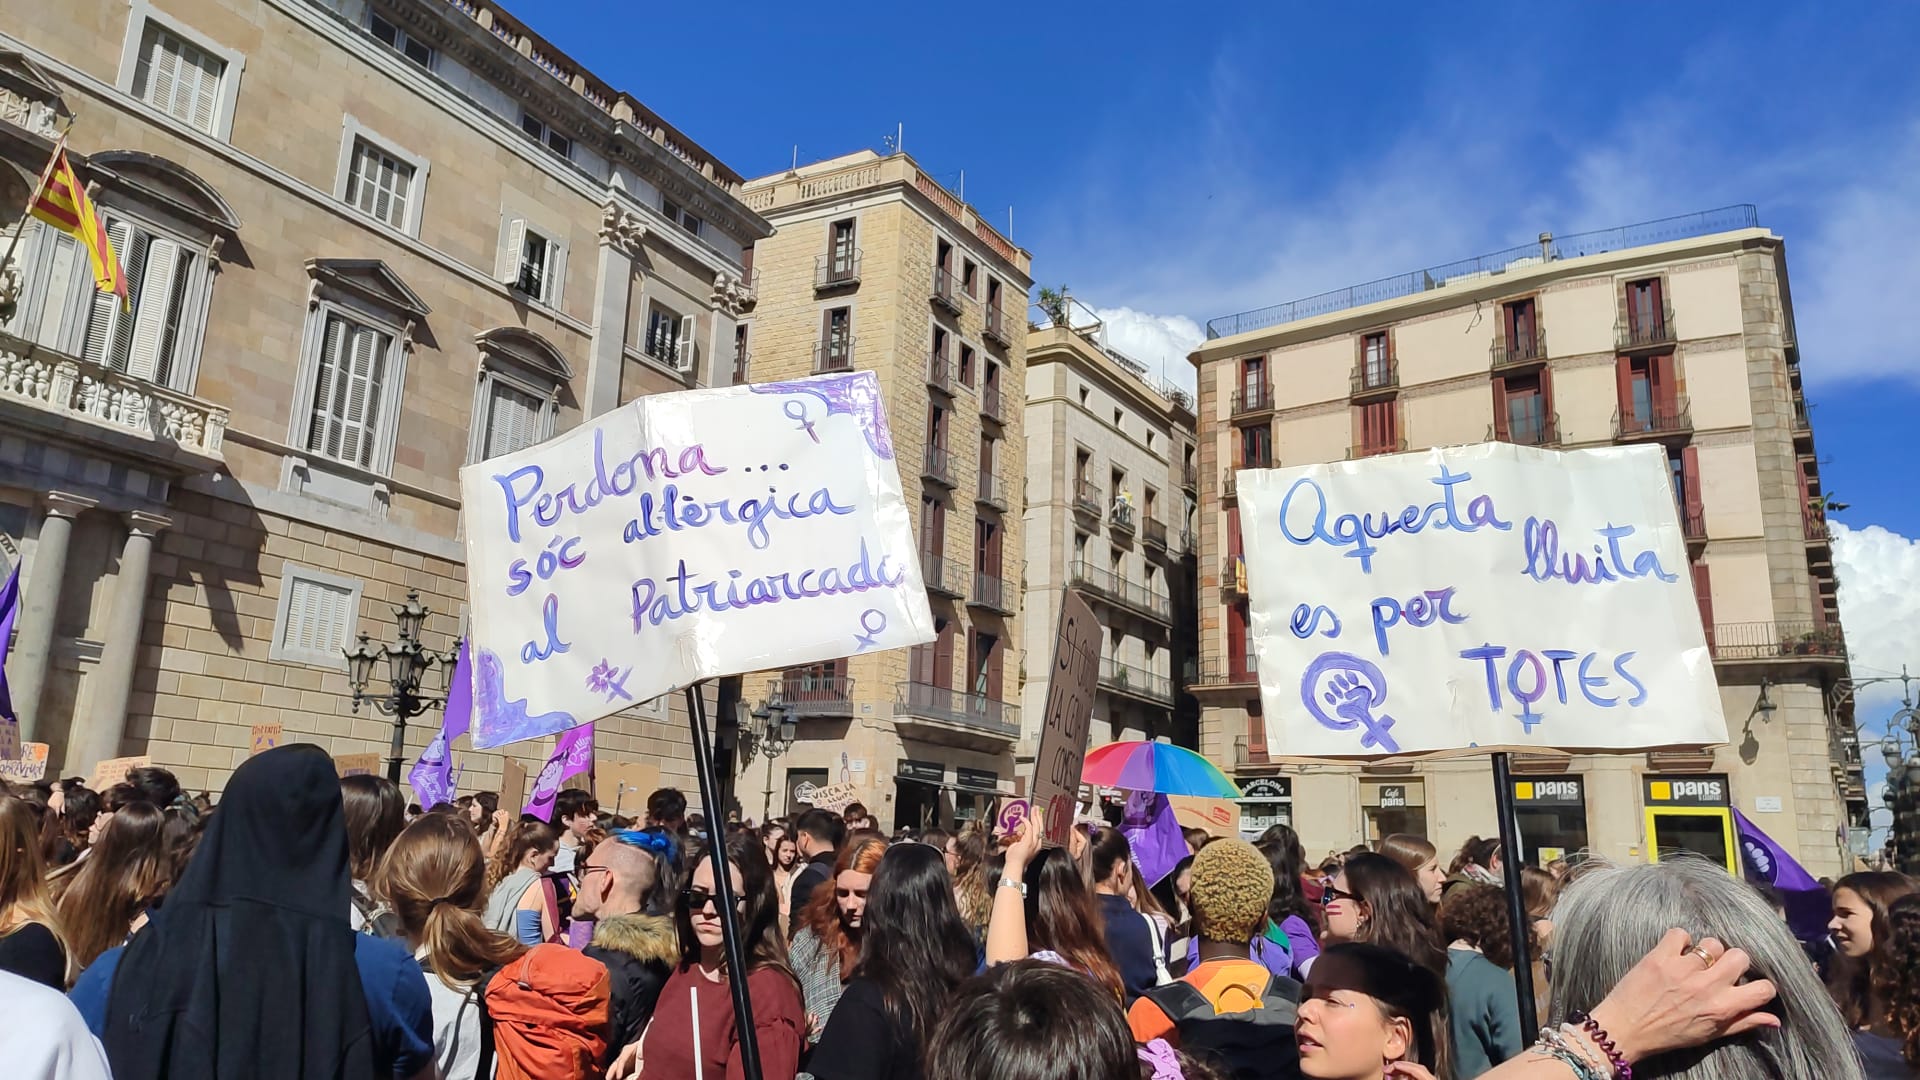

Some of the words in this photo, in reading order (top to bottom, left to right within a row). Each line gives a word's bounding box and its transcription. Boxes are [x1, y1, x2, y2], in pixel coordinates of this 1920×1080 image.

[1280, 464, 1512, 573] Aquesta
[507, 536, 586, 596] sóc
[1521, 516, 1679, 585] lluita
[520, 594, 572, 664] al
[1290, 602, 1342, 638] es
[1370, 585, 1471, 656] per
[1460, 642, 1648, 735] TOTES
[813, 787, 841, 799] VISCA
[1242, 779, 1284, 794] BARCELONA
[1381, 797, 1405, 808] pans
[1535, 781, 1578, 800] pans
[1672, 781, 1721, 800] pans
